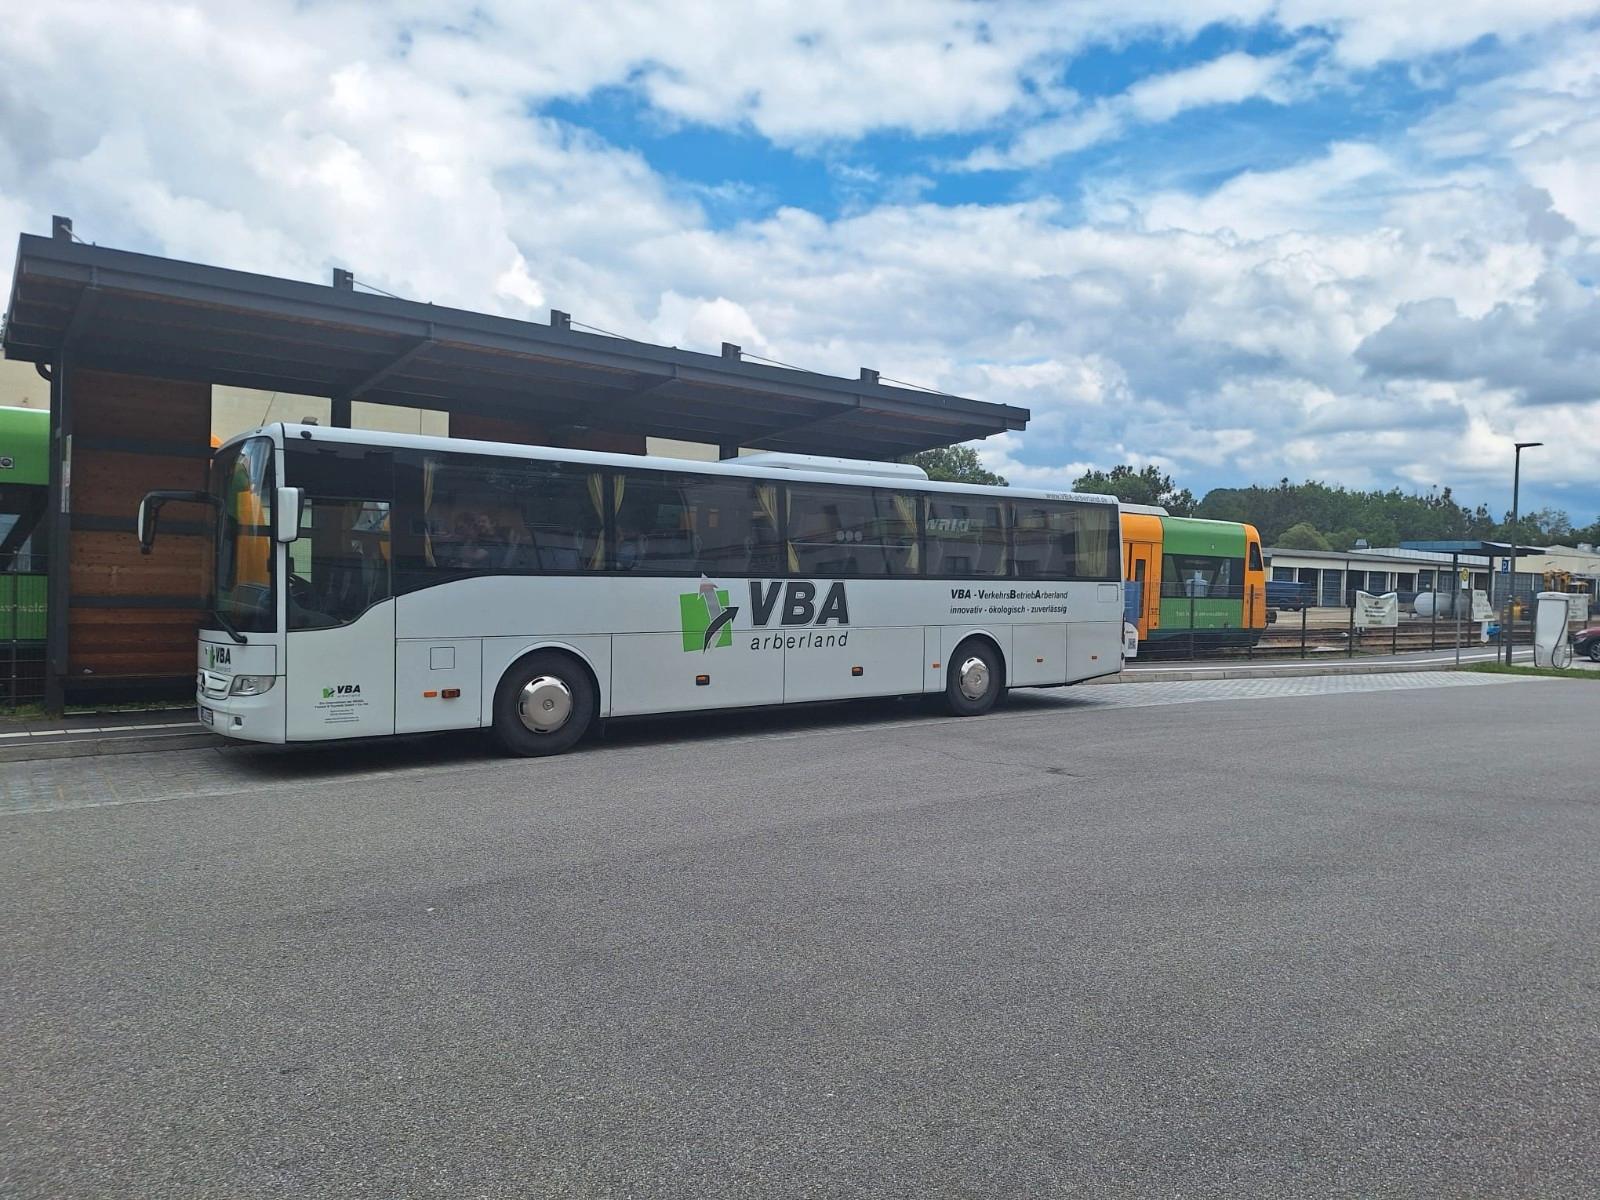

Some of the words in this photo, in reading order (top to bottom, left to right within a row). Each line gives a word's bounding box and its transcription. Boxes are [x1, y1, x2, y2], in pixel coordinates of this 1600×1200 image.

[950, 589, 971, 599] VBA
[978, 589, 1068, 600] VerkehrsBetriebArberland
[748, 579, 850, 628] VBA
[950, 605, 983, 614] innovativ
[988, 605, 1026, 615] ökologisch
[1031, 604, 1067, 615] zuverlässig
[750, 632, 849, 650] arberland
[216, 647, 231, 665] VBA
[337, 684, 361, 694] VBA
